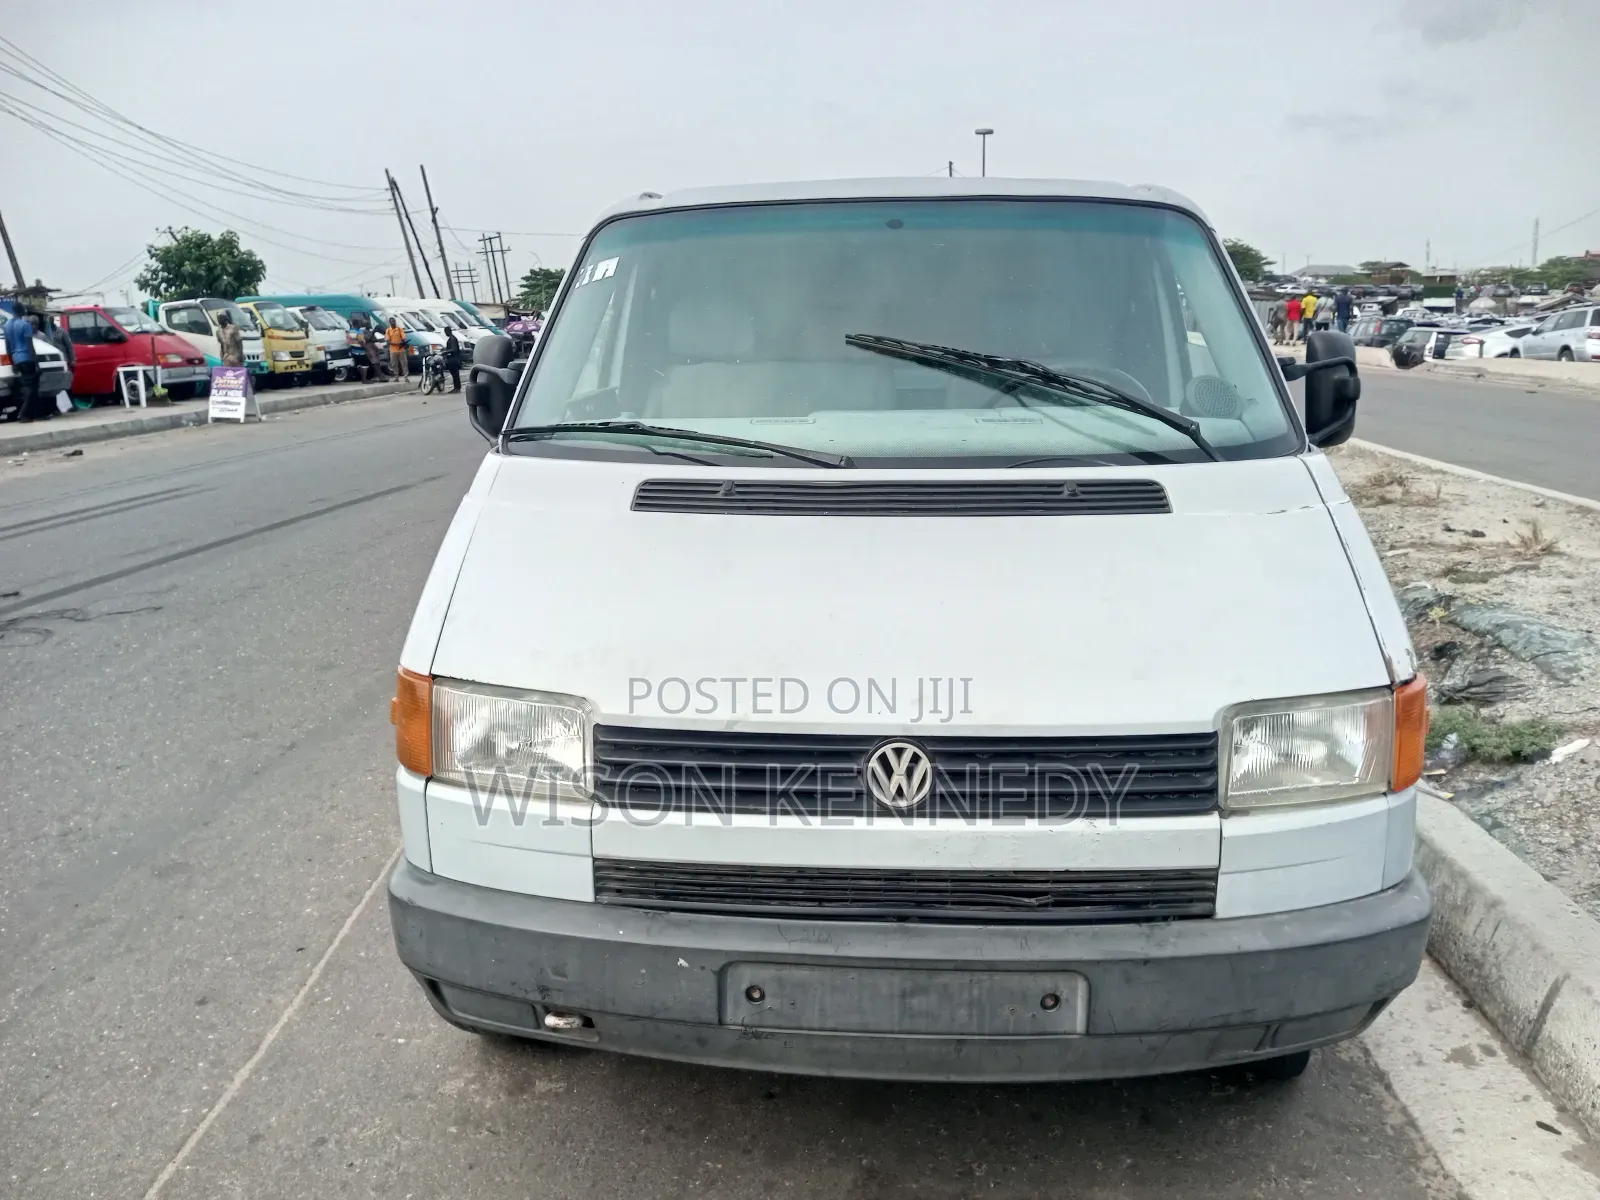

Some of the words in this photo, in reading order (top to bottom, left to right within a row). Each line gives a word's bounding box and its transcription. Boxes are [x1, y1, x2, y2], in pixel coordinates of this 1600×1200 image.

[212, 389, 227, 397] PLAY
[227, 389, 243, 397] HERE
[866, 742, 933, 808] VW
